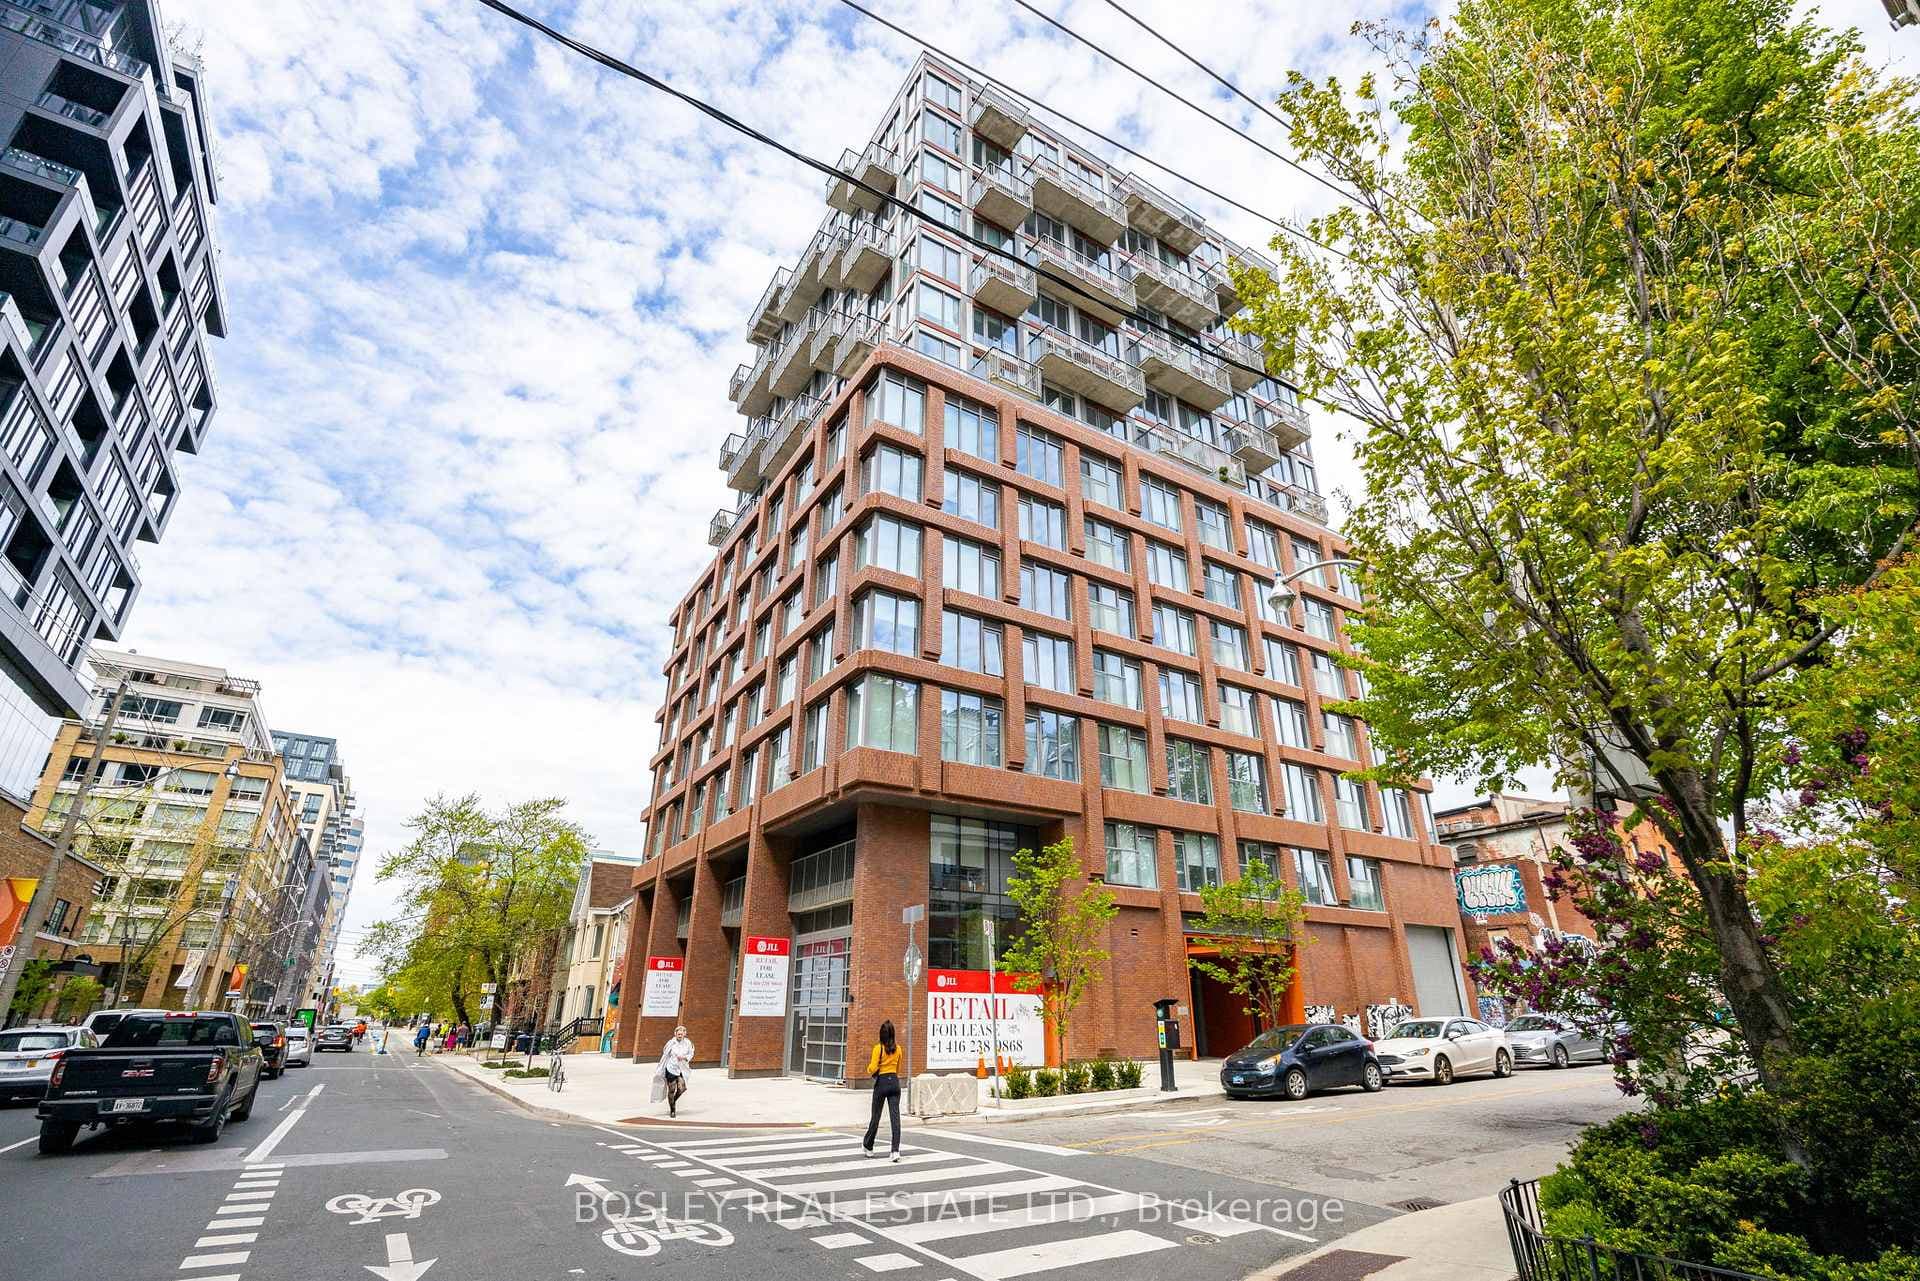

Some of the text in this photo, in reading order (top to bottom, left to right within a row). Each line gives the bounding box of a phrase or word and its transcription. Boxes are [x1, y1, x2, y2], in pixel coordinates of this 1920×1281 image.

[766, 943, 779, 952] JLL
[946, 976, 958, 986] JLL
[932, 997, 1015, 1020] RETAIL
[932, 1023, 958, 1037] FOR
[931, 1040, 942, 1053] +1
[946, 1040, 966, 1053] 416
[970, 1040, 991, 1054] 238
